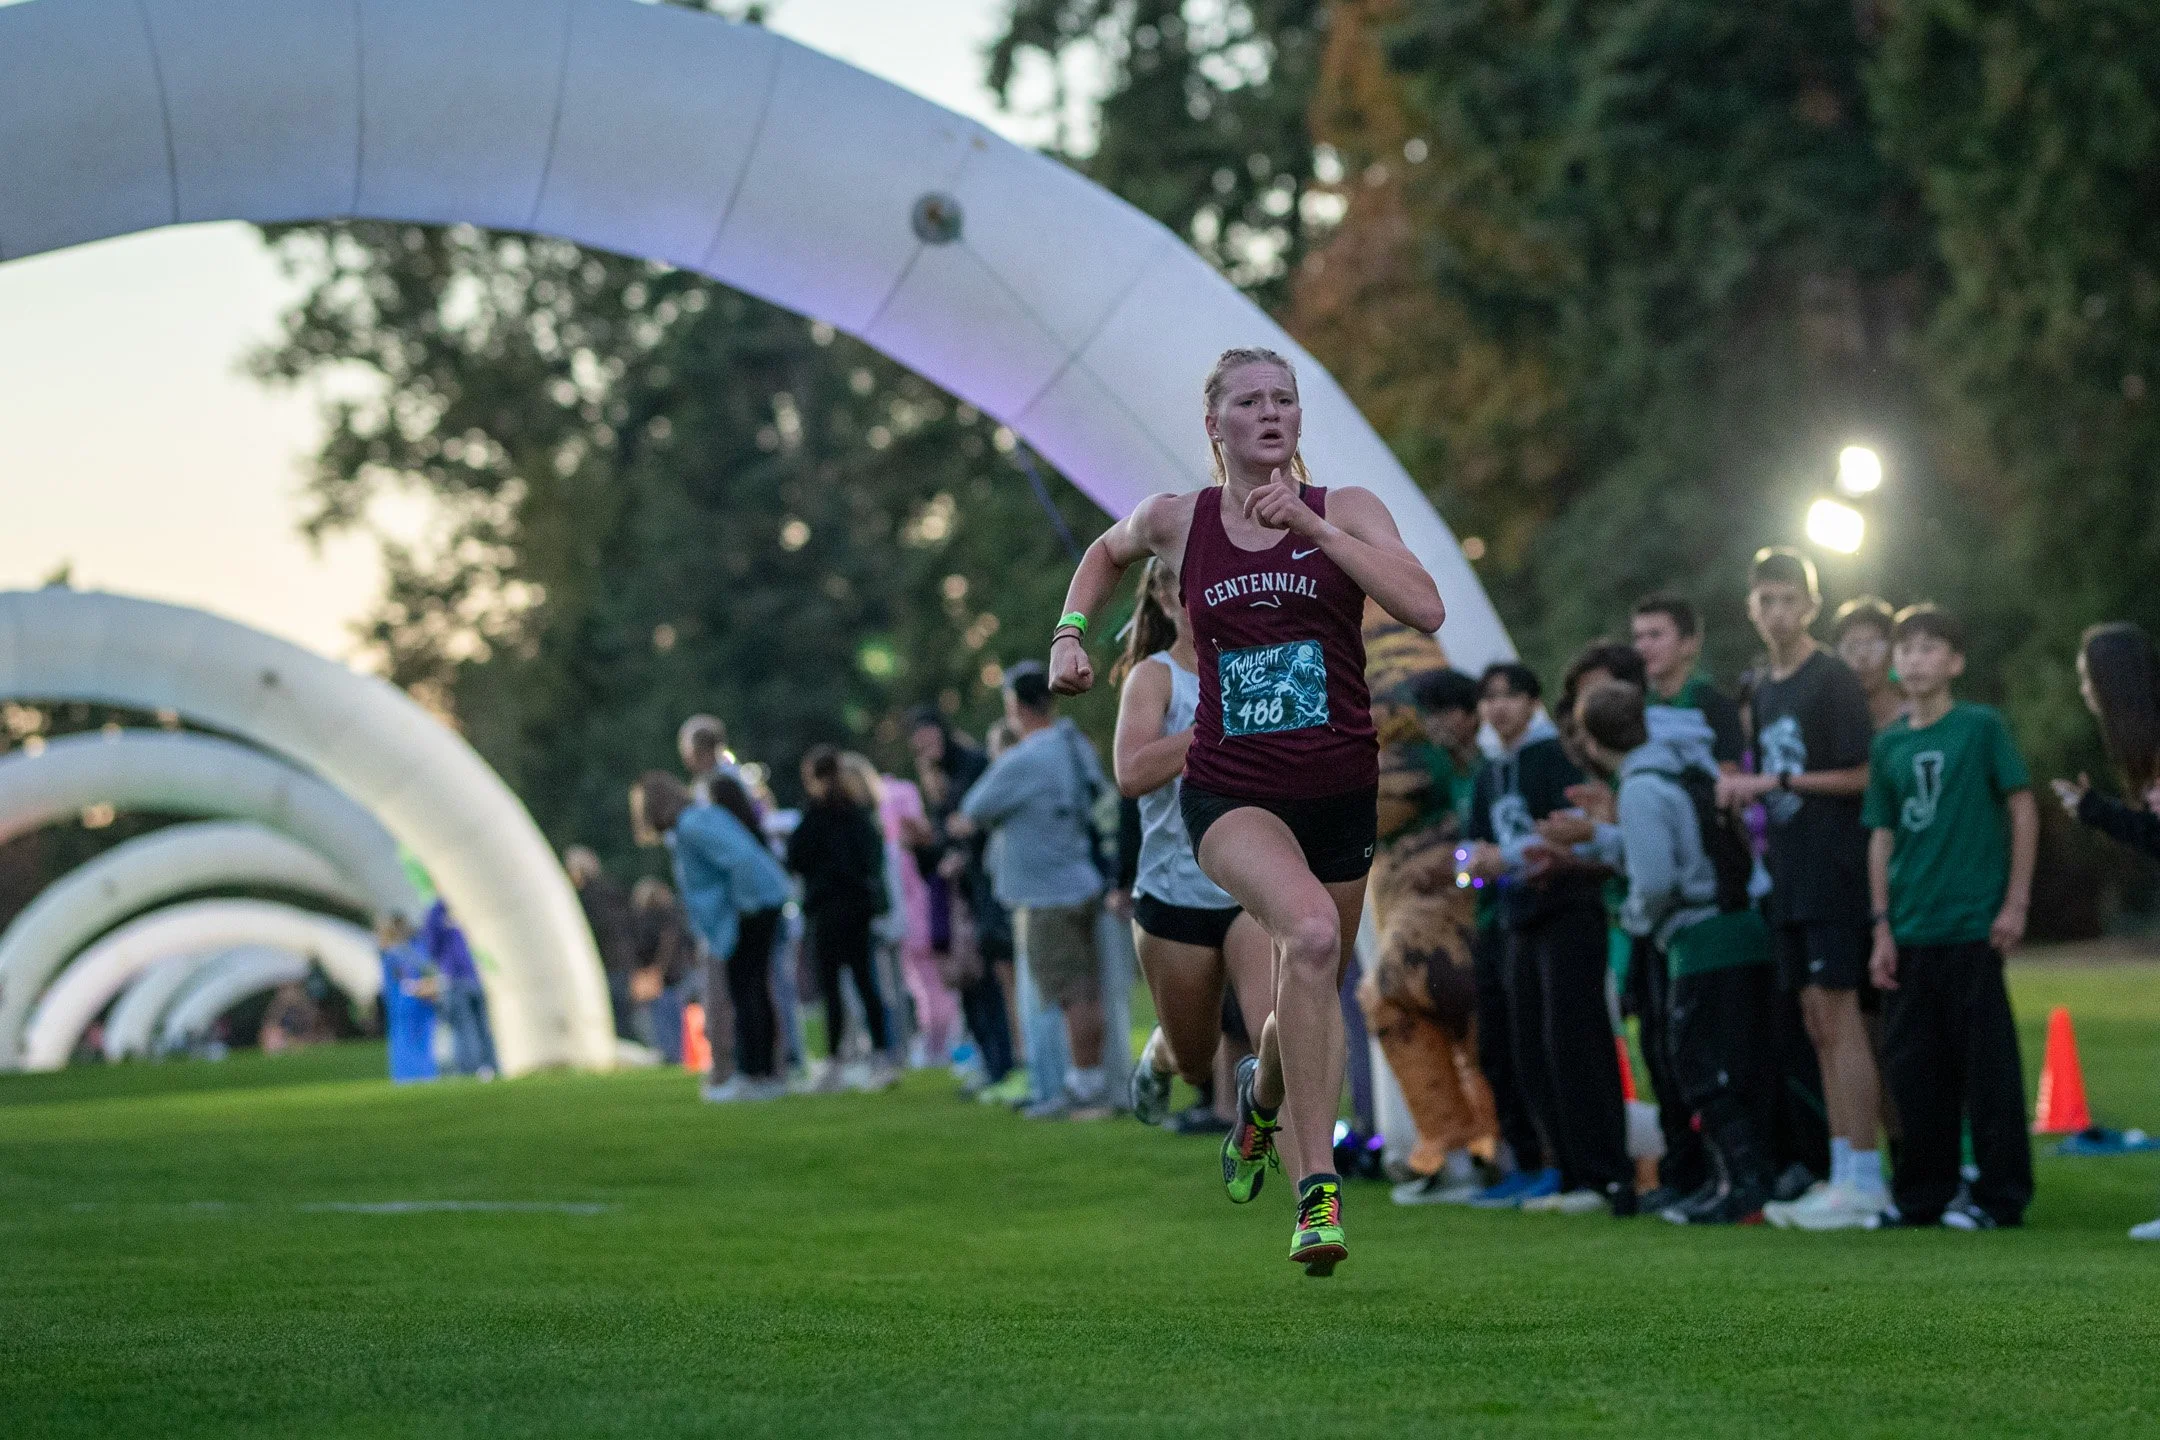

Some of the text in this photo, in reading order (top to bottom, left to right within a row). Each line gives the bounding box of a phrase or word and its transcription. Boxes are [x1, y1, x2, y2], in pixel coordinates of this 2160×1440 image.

[1204, 572, 1317, 607] CENTENNIAL
[1226, 647, 1284, 681] TWILIGHT
[1239, 667, 1266, 691] XC
[1237, 697, 1283, 730] 488
[1901, 750, 1944, 832] J
